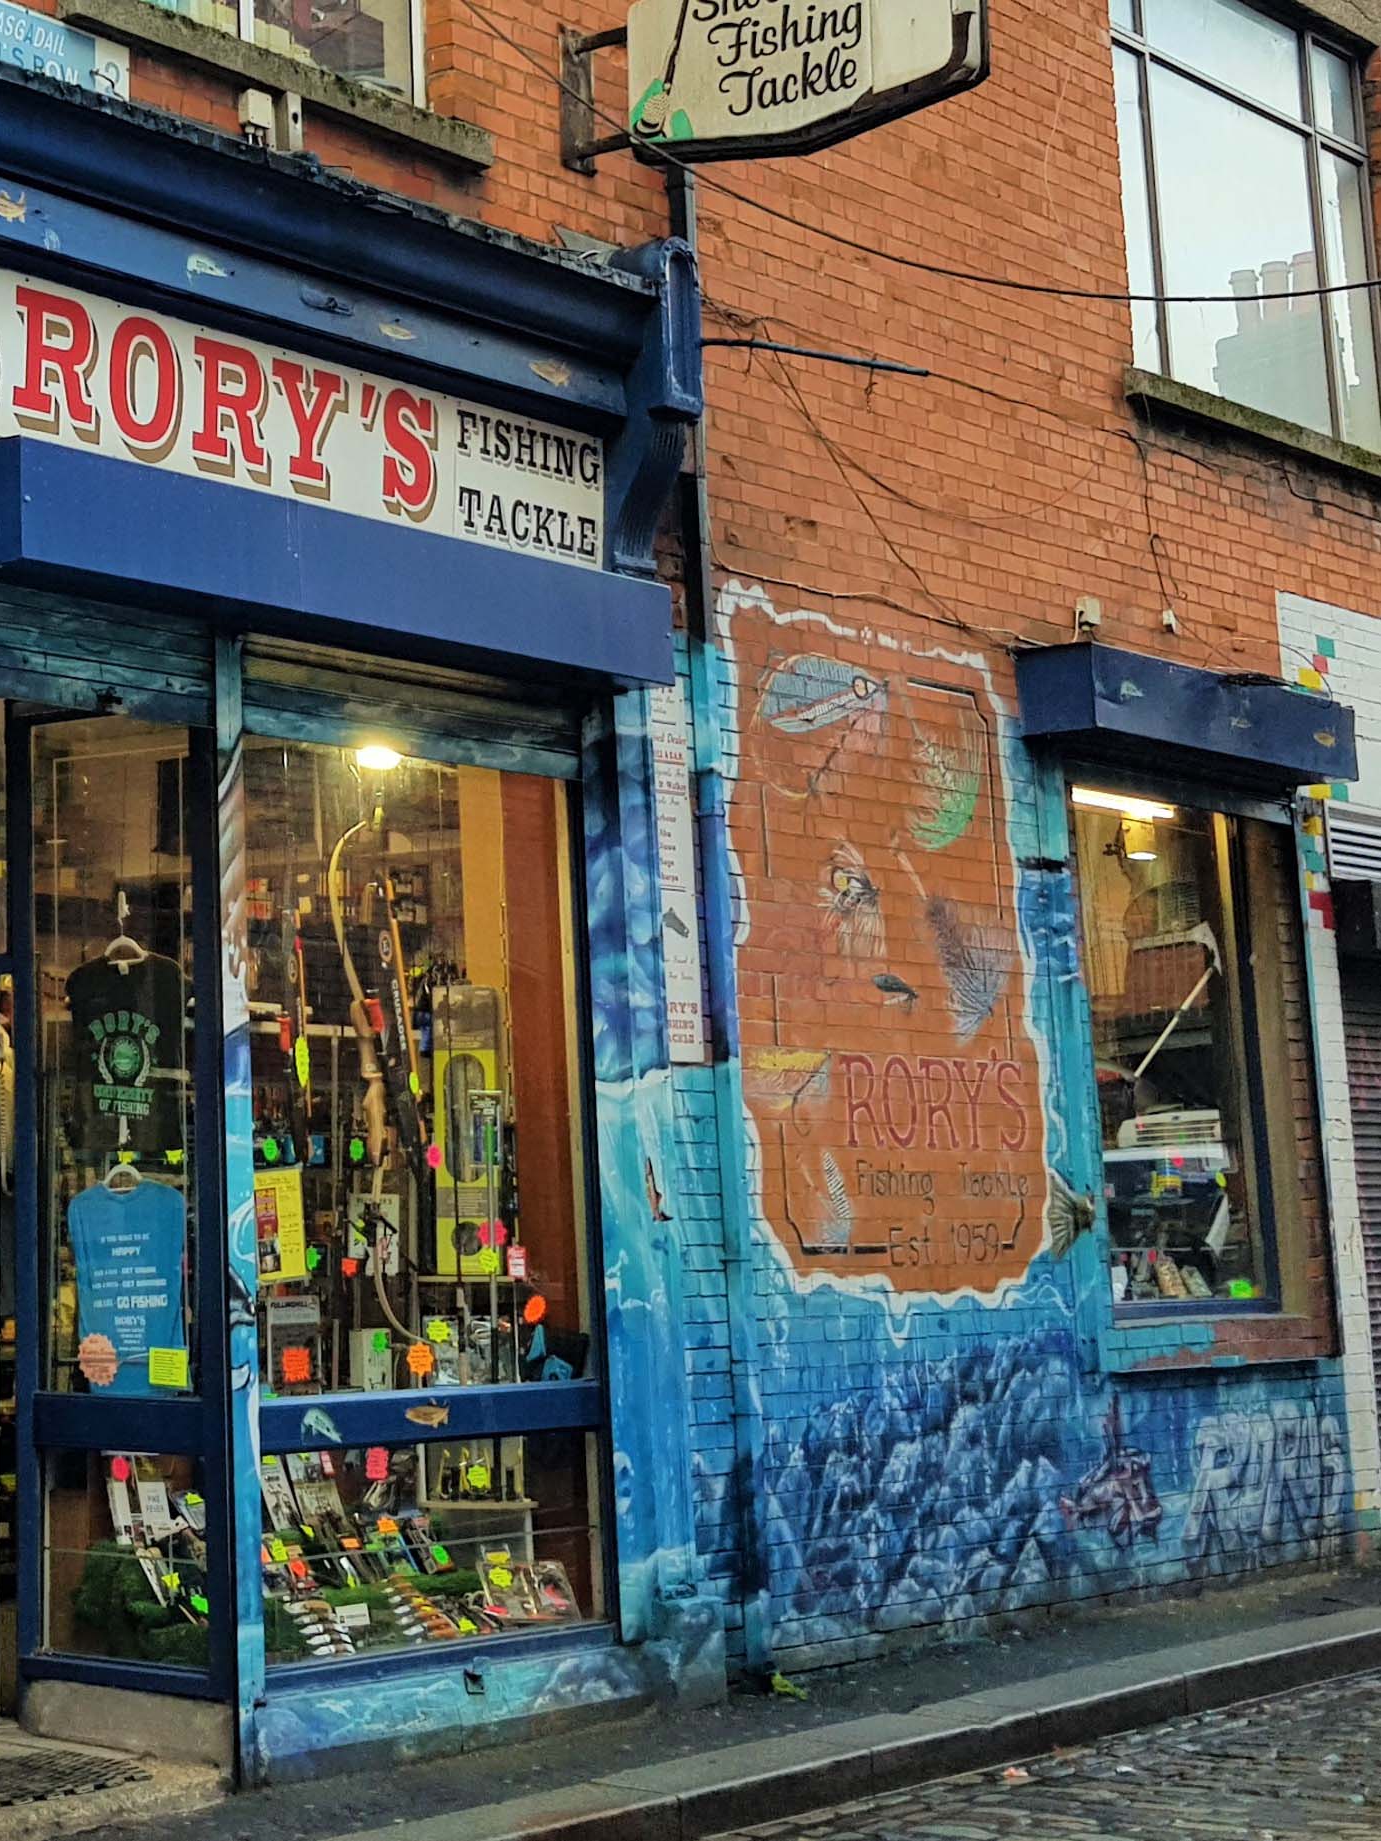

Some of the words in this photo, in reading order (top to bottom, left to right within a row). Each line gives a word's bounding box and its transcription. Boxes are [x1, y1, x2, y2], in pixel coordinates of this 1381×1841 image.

[707, 2, 862, 67] Fishing
[719, 46, 857, 116] Tackle
[13, 285, 439, 524] RORY'S
[456, 408, 601, 488] FISHING
[458, 487, 598, 559] TACKLE
[839, 1047, 1030, 1151] RORY'S
[856, 1159, 934, 1216] Fishing
[958, 1161, 1029, 1198] Tackle
[888, 1227, 939, 1267] Est.
